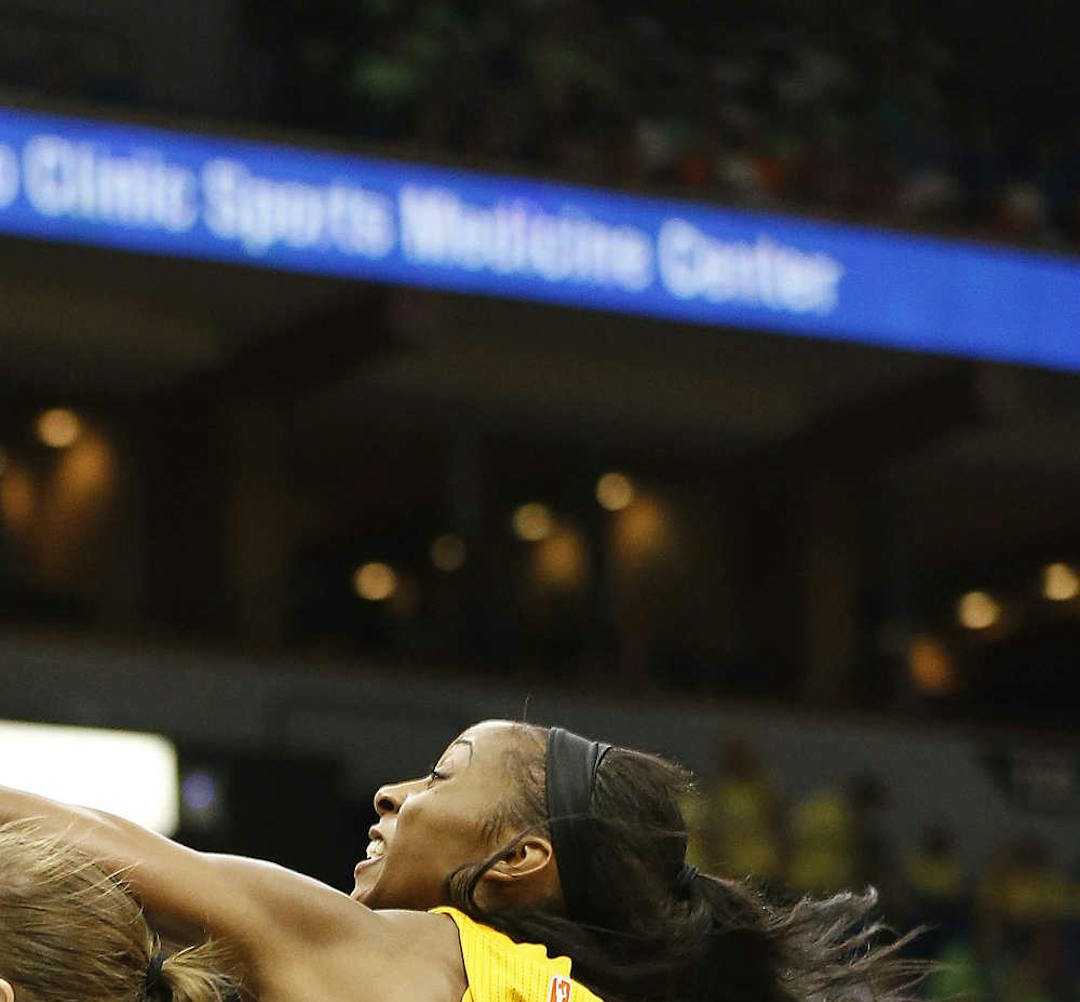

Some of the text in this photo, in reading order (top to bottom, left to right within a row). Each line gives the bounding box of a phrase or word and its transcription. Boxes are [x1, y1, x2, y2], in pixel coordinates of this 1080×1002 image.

[23, 134, 198, 234] Clinic
[202, 158, 395, 260] Sports
[398, 184, 653, 293] Medicine
[658, 217, 843, 316] Center
